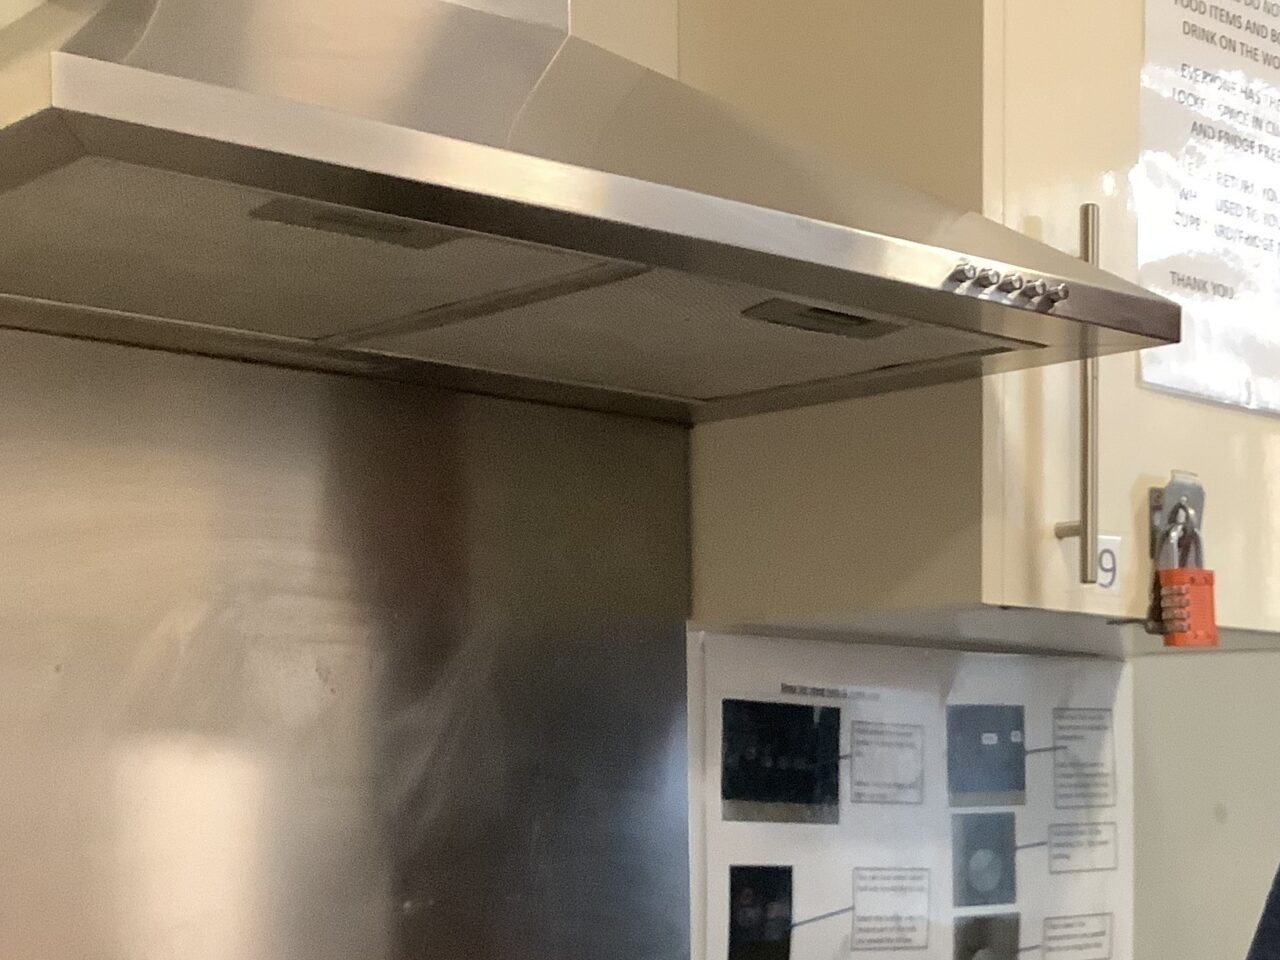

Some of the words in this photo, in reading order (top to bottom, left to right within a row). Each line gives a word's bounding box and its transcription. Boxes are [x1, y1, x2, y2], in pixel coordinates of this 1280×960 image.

[1210, 5, 1242, 30] ITEMS
[1245, 19, 1268, 39] AND
[1183, 20, 1217, 46] DRINK
[1219, 35, 1236, 53] ON
[1239, 42, 1258, 62] THE
[1191, 121, 1215, 140] AND
[1217, 130, 1255, 154] FRIDGE
[1252, 115, 1263, 131] IN
[1169, 270, 1209, 294] THANK
